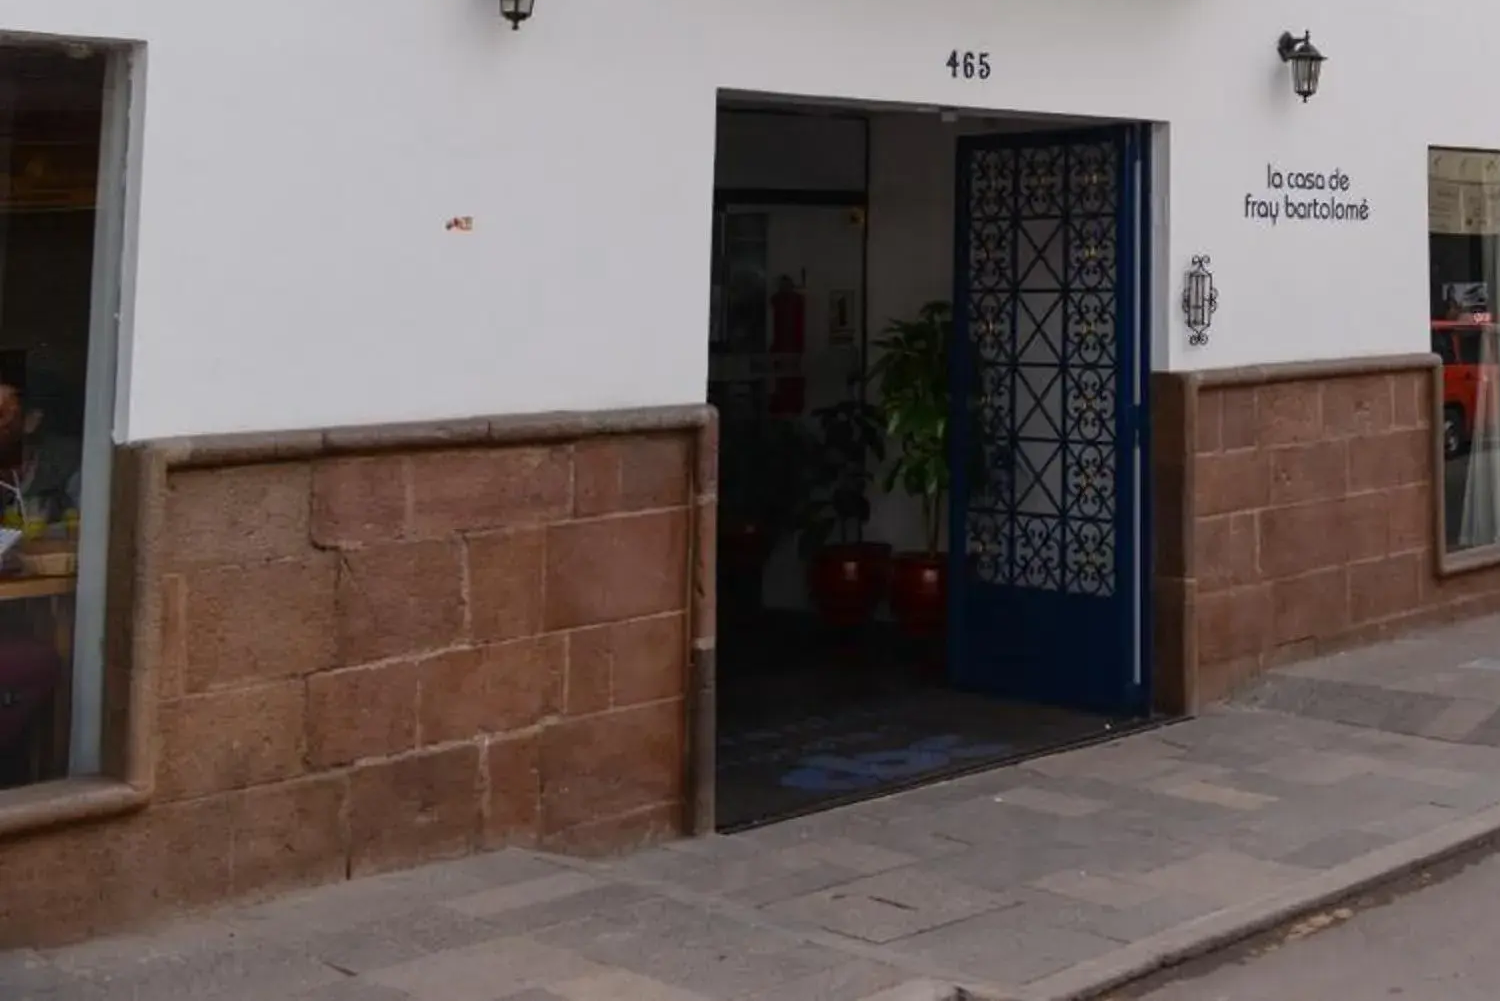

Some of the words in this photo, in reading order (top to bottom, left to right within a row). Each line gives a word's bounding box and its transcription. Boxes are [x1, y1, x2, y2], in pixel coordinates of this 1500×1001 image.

[945, 49, 991, 80] 465
[1267, 163, 1284, 190] la
[1287, 171, 1326, 191] casa
[1328, 166, 1350, 192] de
[1244, 193, 1280, 225] fray
[1284, 193, 1370, 221] bartolomé
